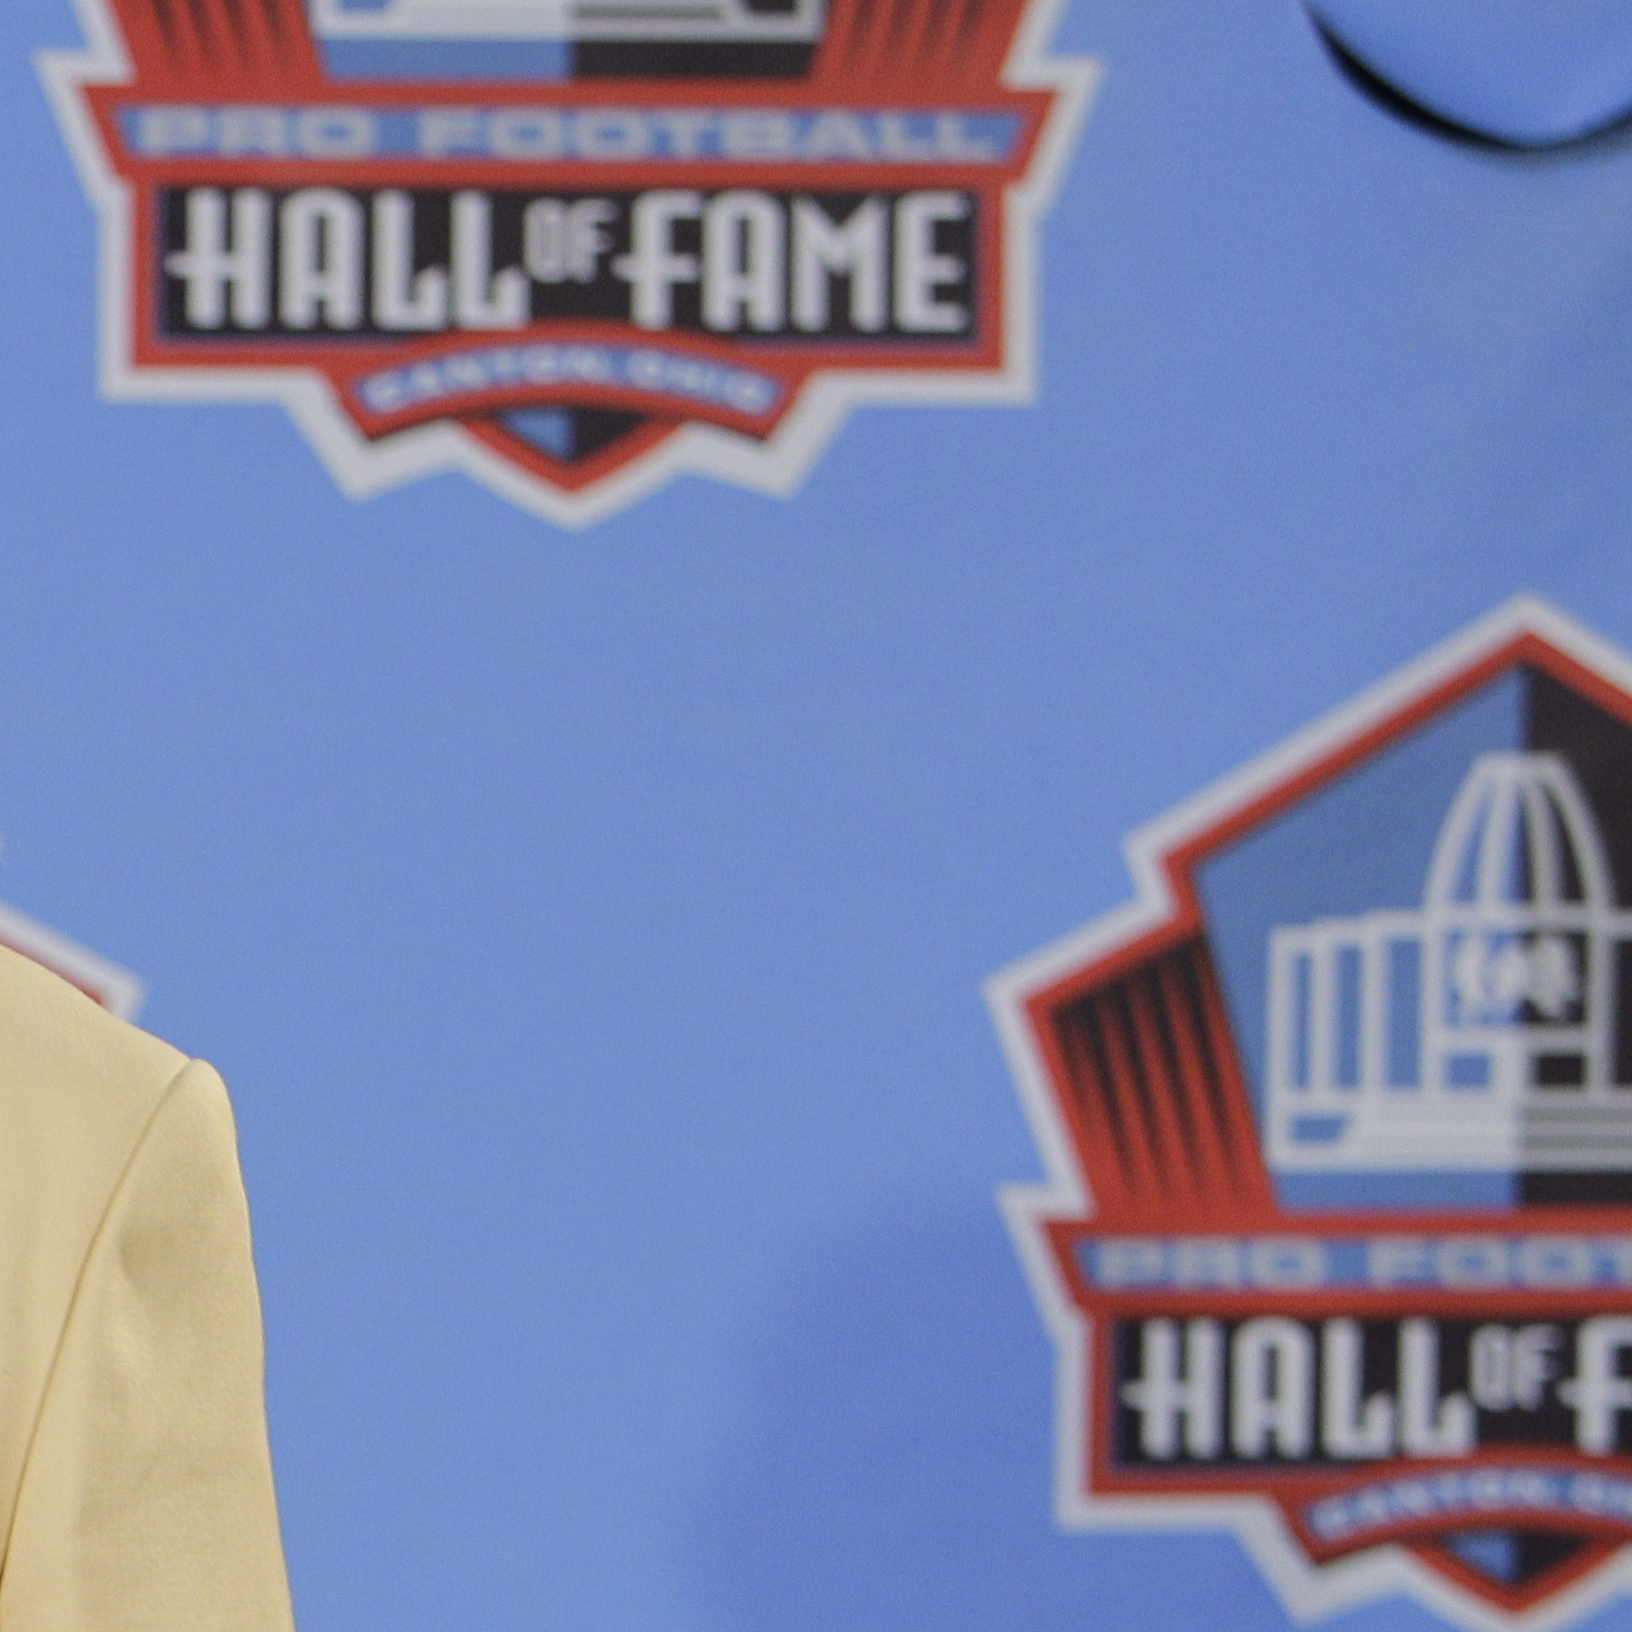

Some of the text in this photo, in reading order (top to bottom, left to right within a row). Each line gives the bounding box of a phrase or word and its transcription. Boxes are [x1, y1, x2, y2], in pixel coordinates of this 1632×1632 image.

[139, 106, 997, 163] PRO FOOTBALL
[167, 187, 968, 331] HALL OF FAME
[1121, 1316, 1477, 1459] HALL
[1469, 1324, 1562, 1411] OF
